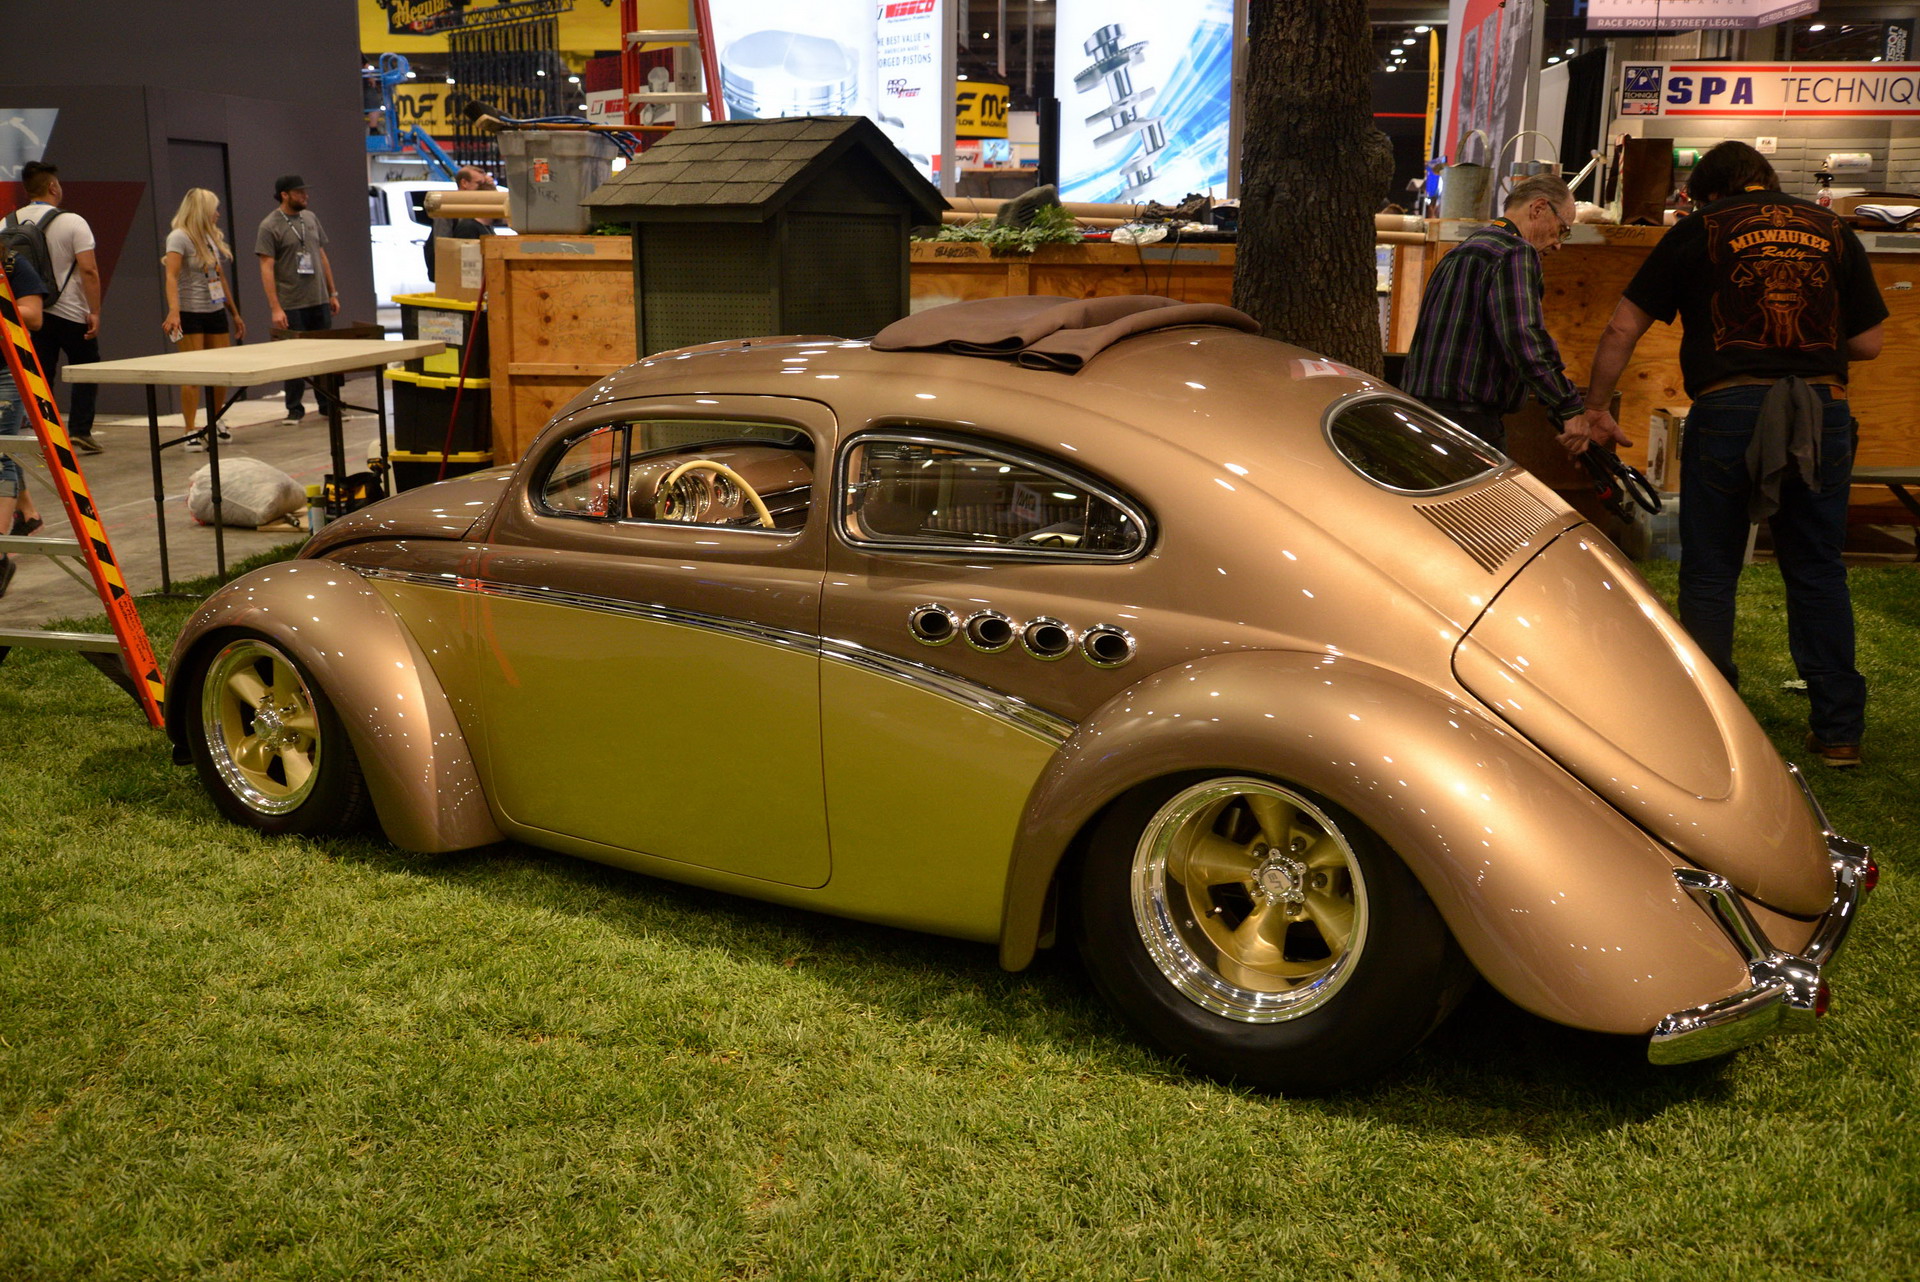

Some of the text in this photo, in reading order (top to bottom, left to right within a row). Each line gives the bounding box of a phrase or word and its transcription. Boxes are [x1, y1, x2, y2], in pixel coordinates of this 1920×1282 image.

[1598, 19, 1624, 27] RACE
[1626, 19, 1668, 27] PROVEN.
[1670, 19, 1707, 27] STREET
[886, 35, 900, 46] BEST
[902, 32, 921, 43] VALUE
[923, 31, 931, 41] IN
[878, 52, 932, 68] ORGED PISTONS
[1666, 77, 1753, 104] SPA
[1761, 246, 1806, 260] Rally
